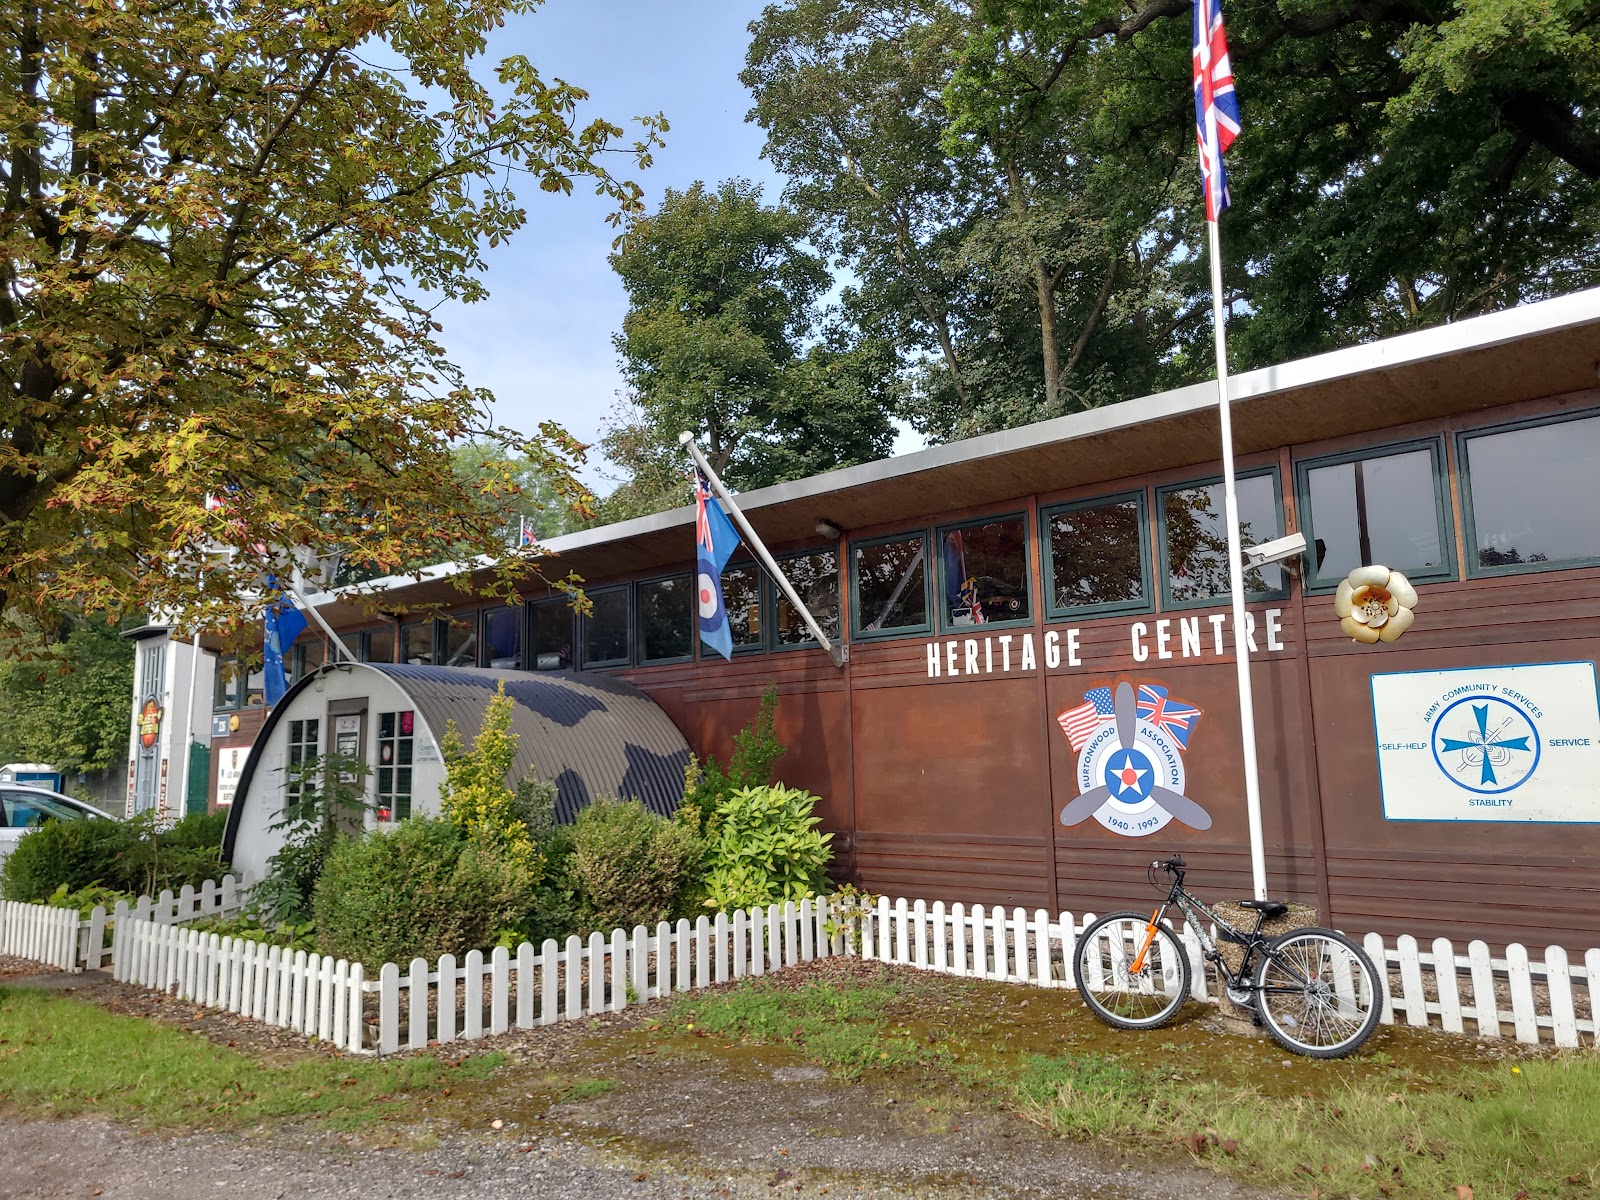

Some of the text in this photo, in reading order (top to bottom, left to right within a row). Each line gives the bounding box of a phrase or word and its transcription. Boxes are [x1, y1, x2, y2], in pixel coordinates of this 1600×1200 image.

[926, 608, 1284, 678] HERITAGE CENTRE
[1423, 683, 1543, 724] ARMY COMMUNITY SERVICES
[1381, 742, 1428, 751] SELF-HELP
[1549, 738, 1591, 747] SERVICE
[1082, 727, 1179, 788] BURTONWOOD ASSOCIATION
[1469, 799, 1513, 807] STABILITY
[1108, 816, 1128, 830] 1940
[1137, 816, 1159, 831] 1993
